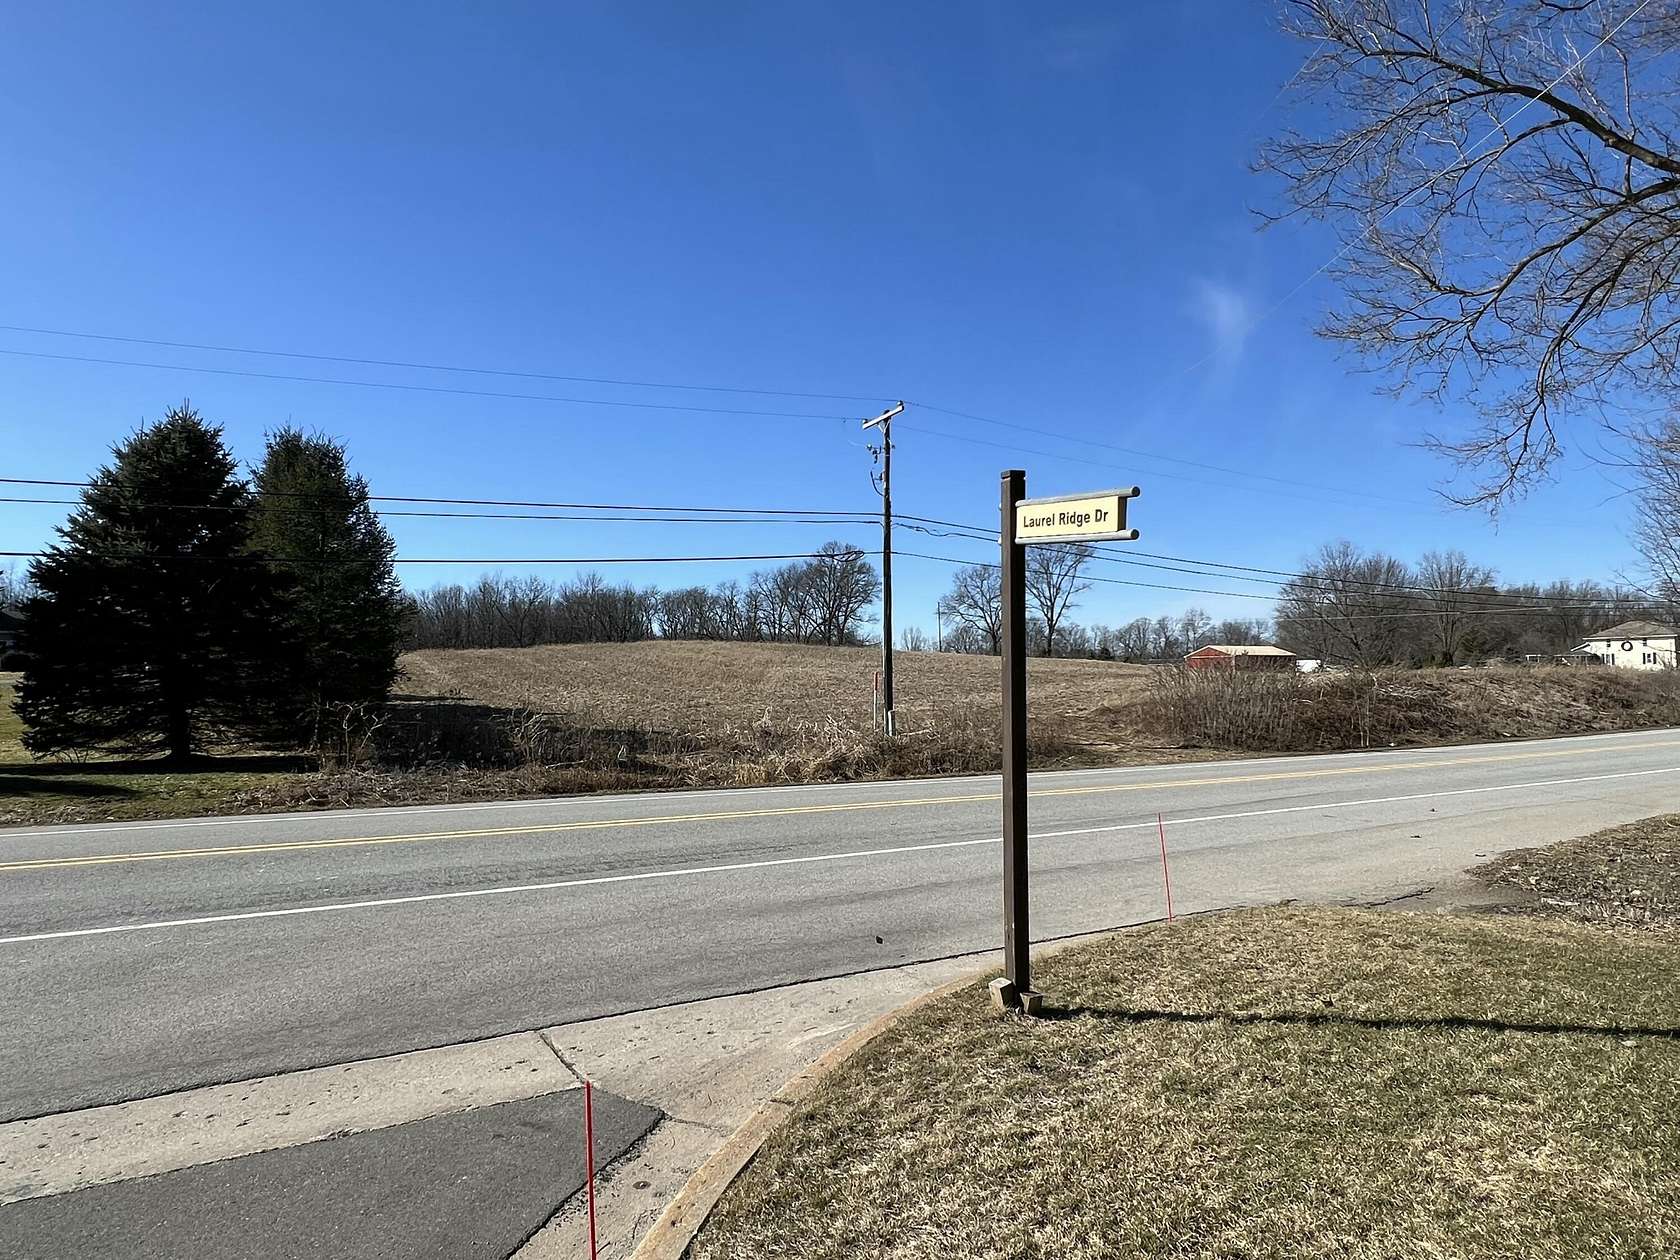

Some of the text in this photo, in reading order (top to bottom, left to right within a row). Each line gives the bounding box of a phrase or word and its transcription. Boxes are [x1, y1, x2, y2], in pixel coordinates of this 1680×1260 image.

[1023, 509, 1109, 528] Laurel Ridge Dr
